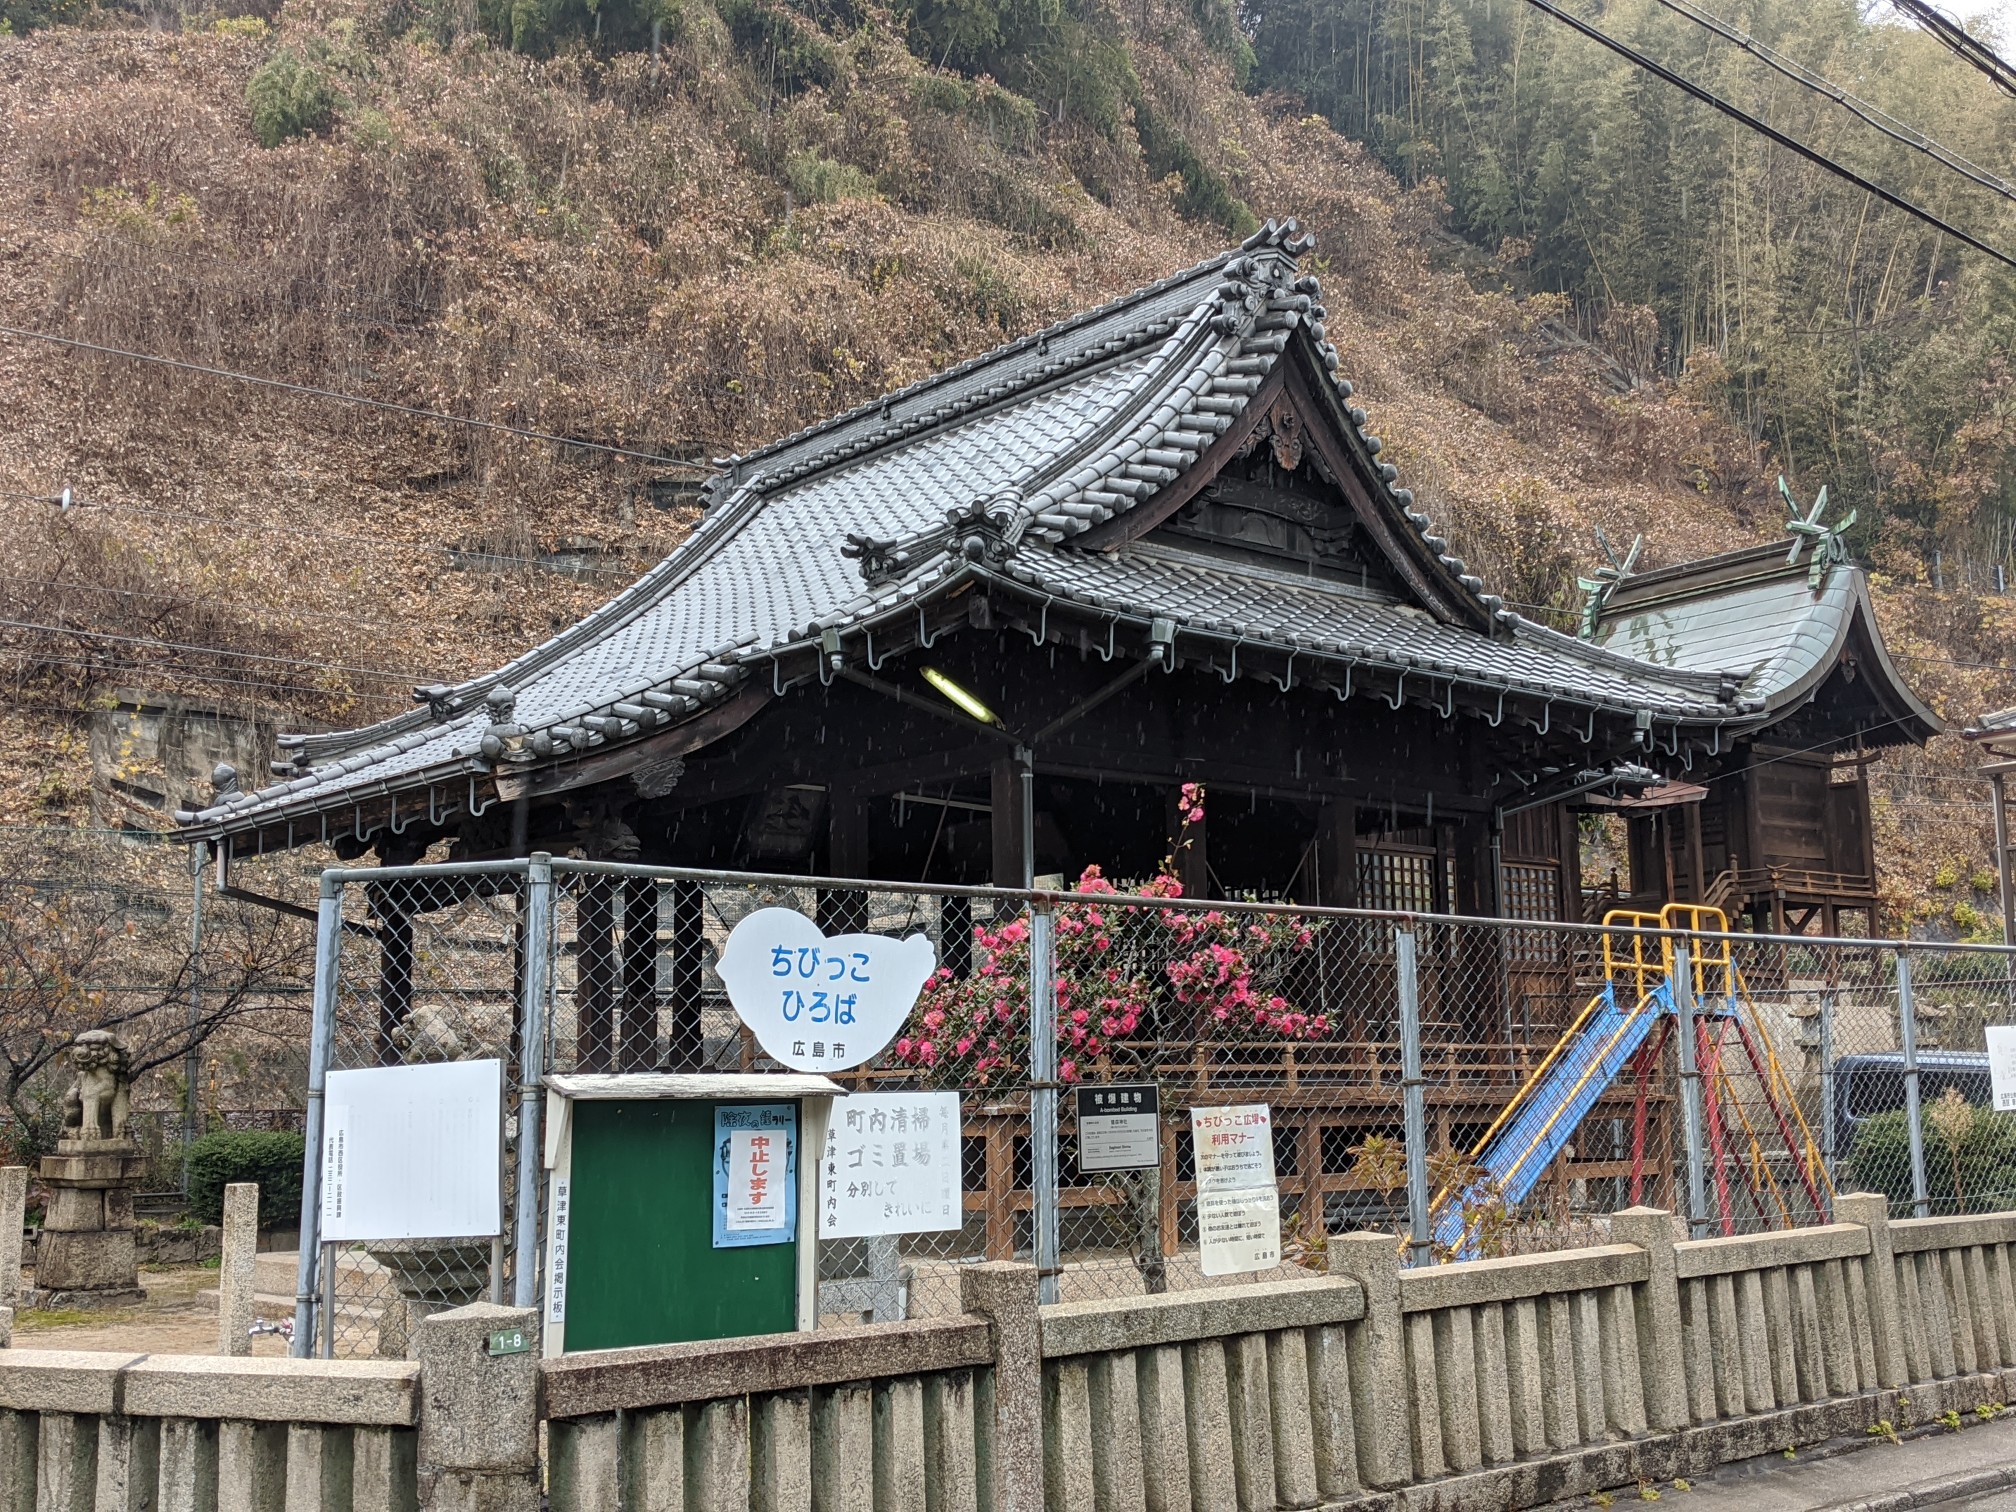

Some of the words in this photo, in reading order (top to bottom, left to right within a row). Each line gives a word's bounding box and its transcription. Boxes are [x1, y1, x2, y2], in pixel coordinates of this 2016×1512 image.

[771, 944, 871, 982] ちびっこ
[782, 990, 858, 1025] ひろば
[792, 1040, 846, 1059] 広島市
[1094, 1092, 1142, 1105] 被爆建物
[846, 1106, 931, 1134] 町内清掃
[1203, 1113, 1259, 1128] ちびっこ広場
[1211, 1132, 1255, 1146] 利用マナー
[847, 1142, 931, 1168] ゴミ置場
[749, 1136, 770, 1205] 中止します
[826, 1128, 838, 1227] 草津東町内会
[847, 1180, 898, 1199] 分別して
[553, 1186, 567, 1313] 草津東町内会掲示板
[1254, 1250, 1275, 1260] 広島市
[499, 1334, 521, 1349] 1-8
